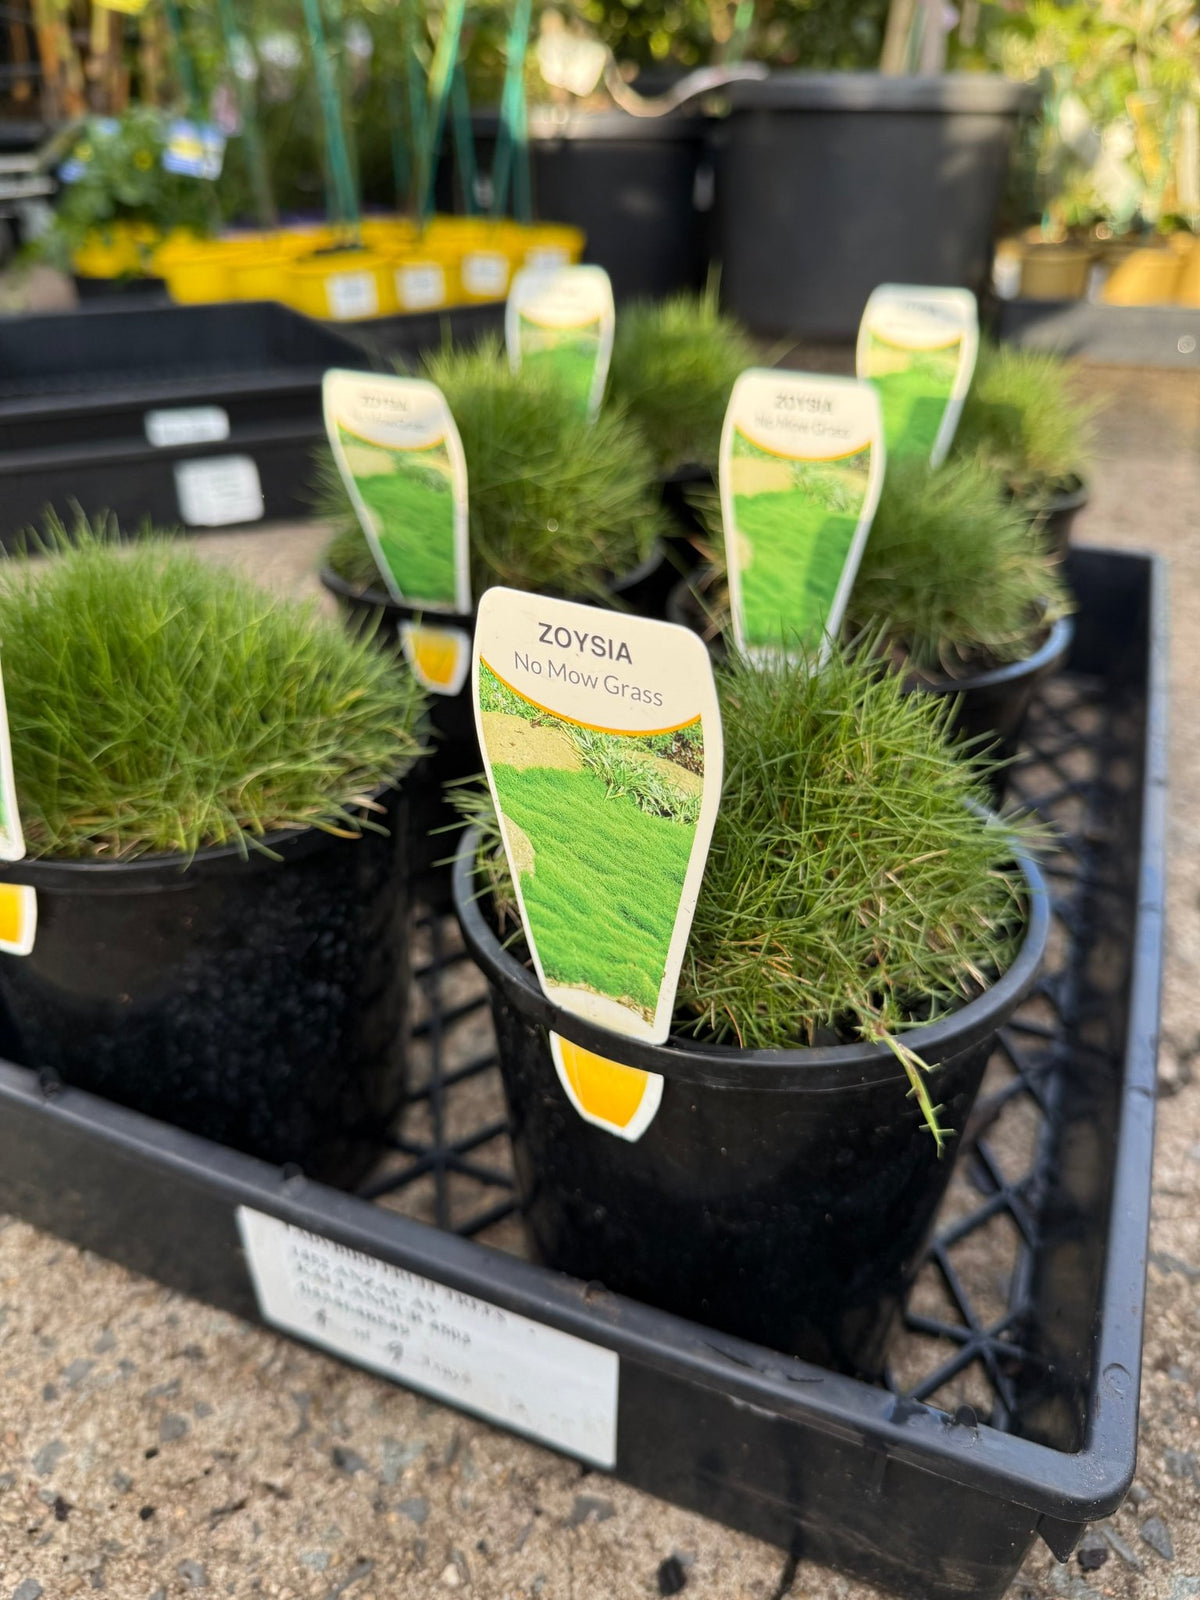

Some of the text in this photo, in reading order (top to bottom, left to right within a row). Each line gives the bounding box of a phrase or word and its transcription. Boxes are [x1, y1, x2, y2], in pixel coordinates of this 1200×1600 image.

[538, 622, 633, 664] ZOYSIA
[514, 651, 664, 707] No Mow Grass
